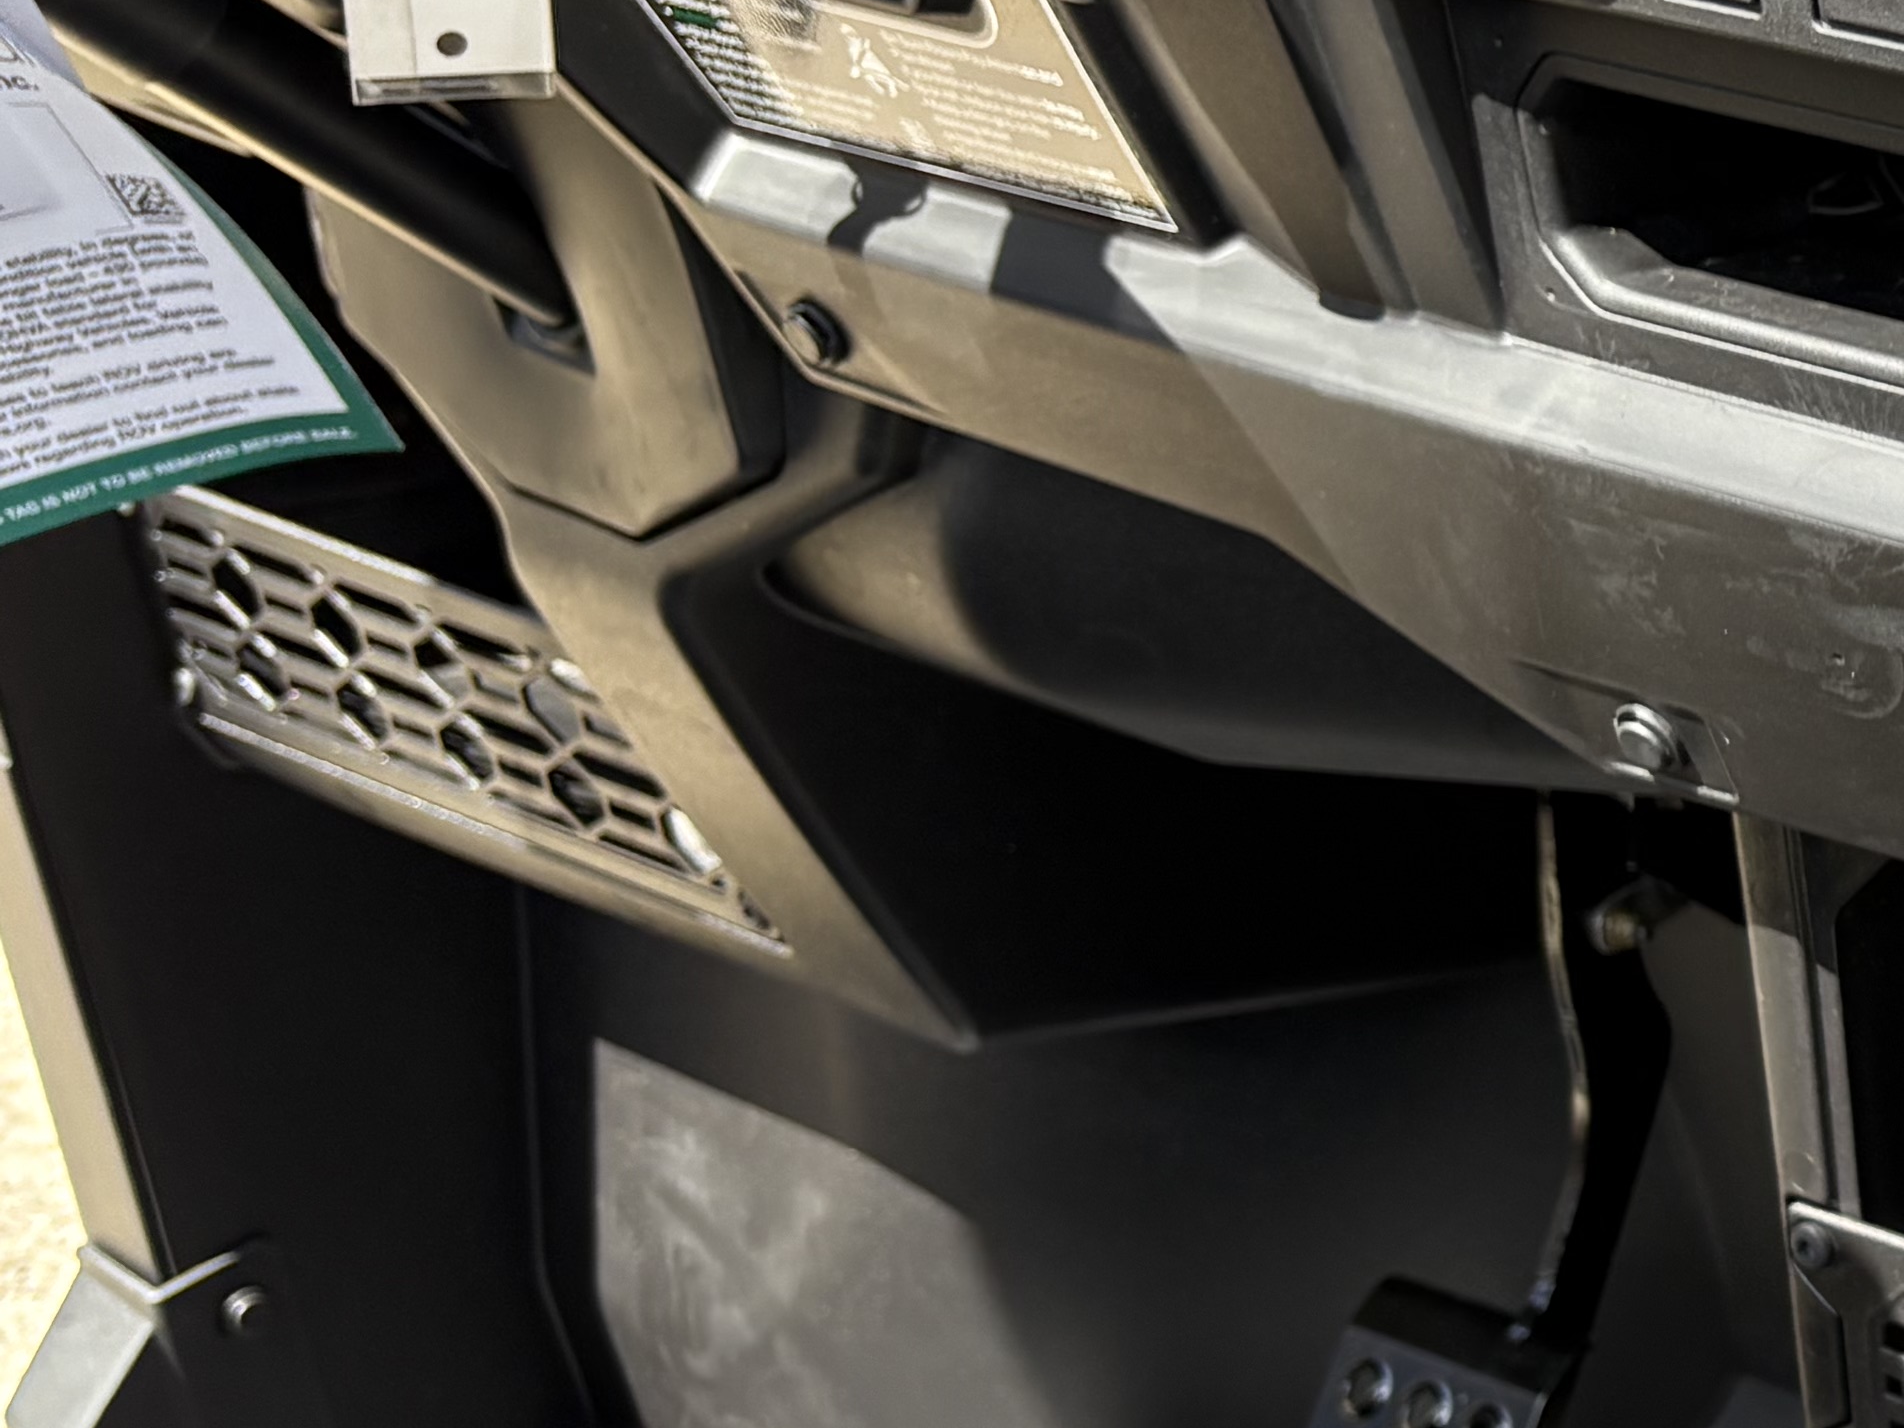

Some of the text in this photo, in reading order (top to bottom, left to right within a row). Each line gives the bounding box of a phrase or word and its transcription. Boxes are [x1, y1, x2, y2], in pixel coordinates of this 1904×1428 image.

[0, 74, 39, 91] nc.
[0, 333, 74, 354] Highway
[3, 500, 41, 523] TAG
[42, 492, 62, 509] IS
[62, 480, 99, 503] NOT
[100, 473, 127, 492] TO
[128, 467, 152, 485] BE
[153, 442, 240, 475] REMOVED
